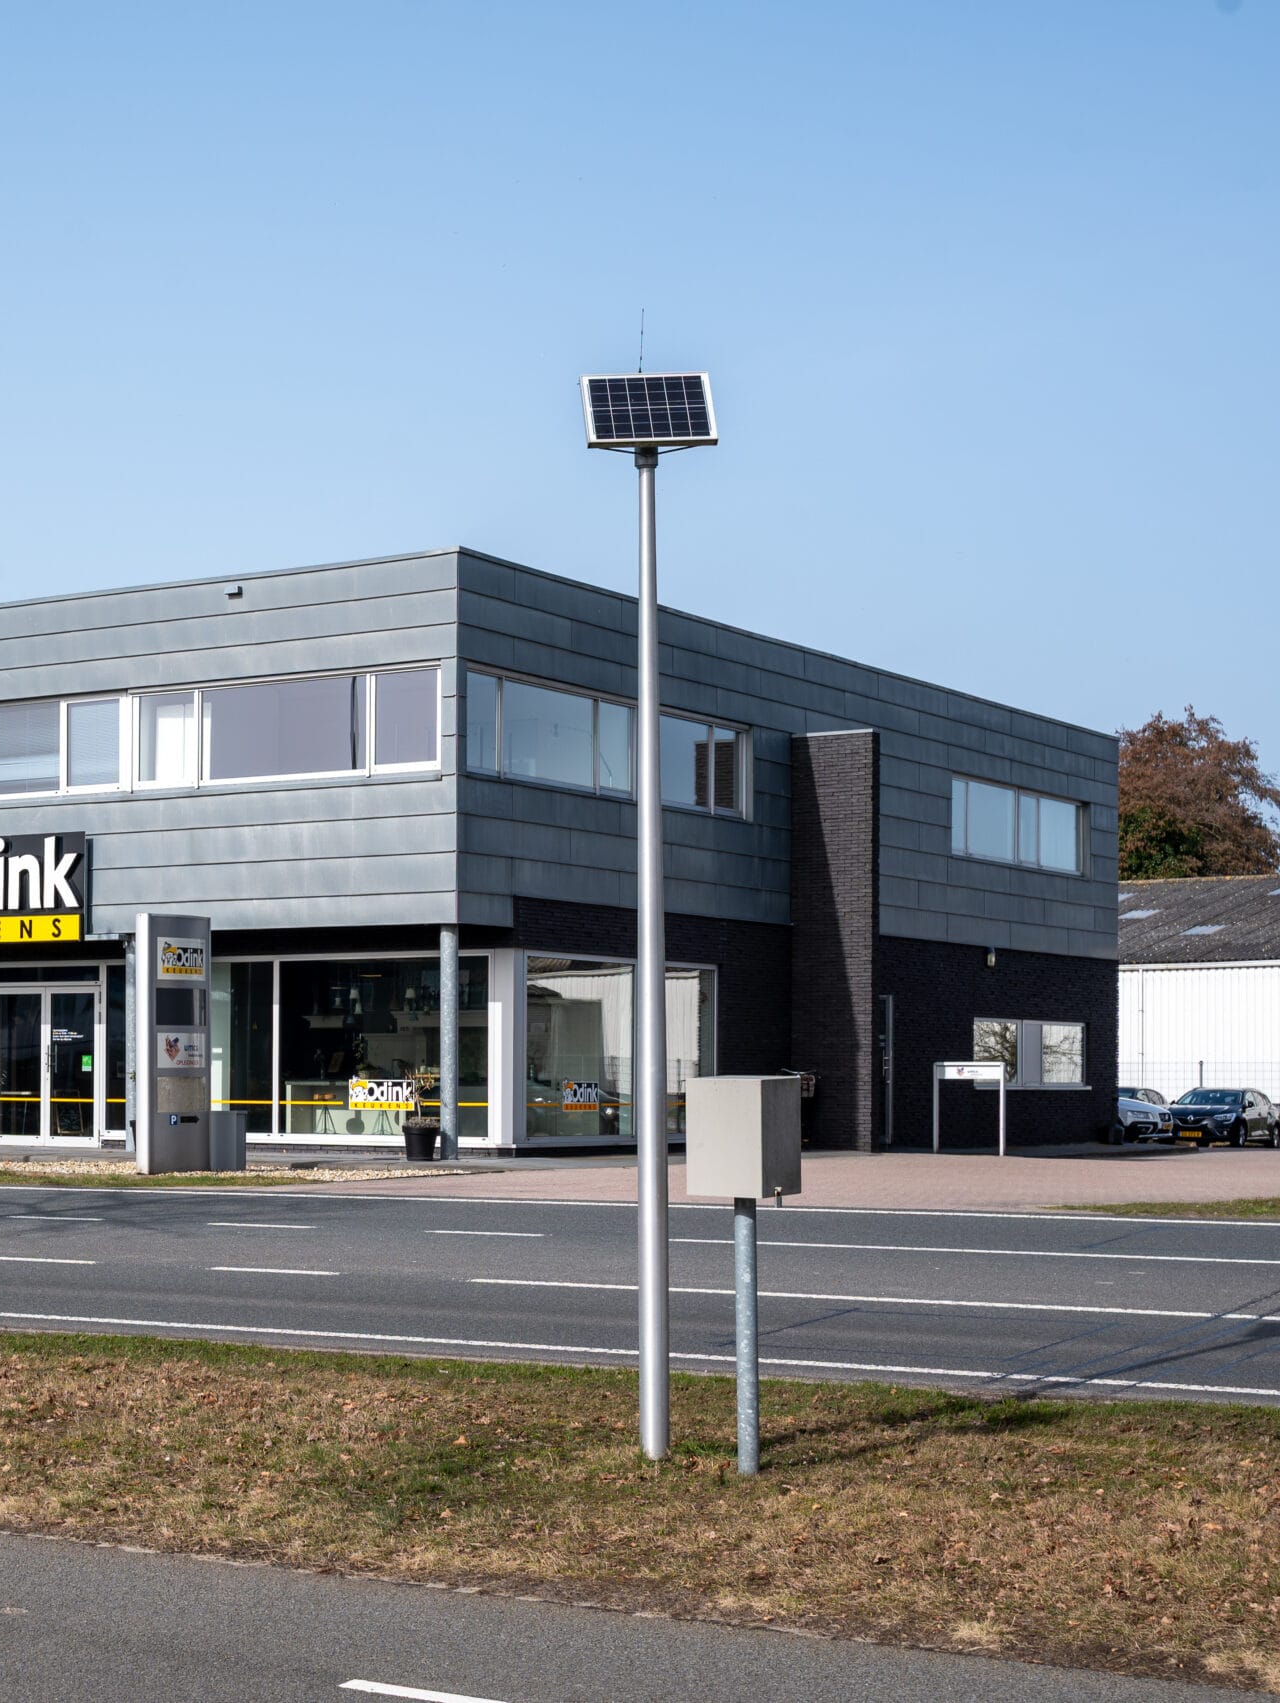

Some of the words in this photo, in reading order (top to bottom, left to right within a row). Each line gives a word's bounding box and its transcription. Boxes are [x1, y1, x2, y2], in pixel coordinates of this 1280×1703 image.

[176, 947, 203, 967] Odink
[367, 1081, 413, 1101] Odink
[573, 1083, 598, 1102] Odink
[354, 1102, 409, 1110] KEUKENS
